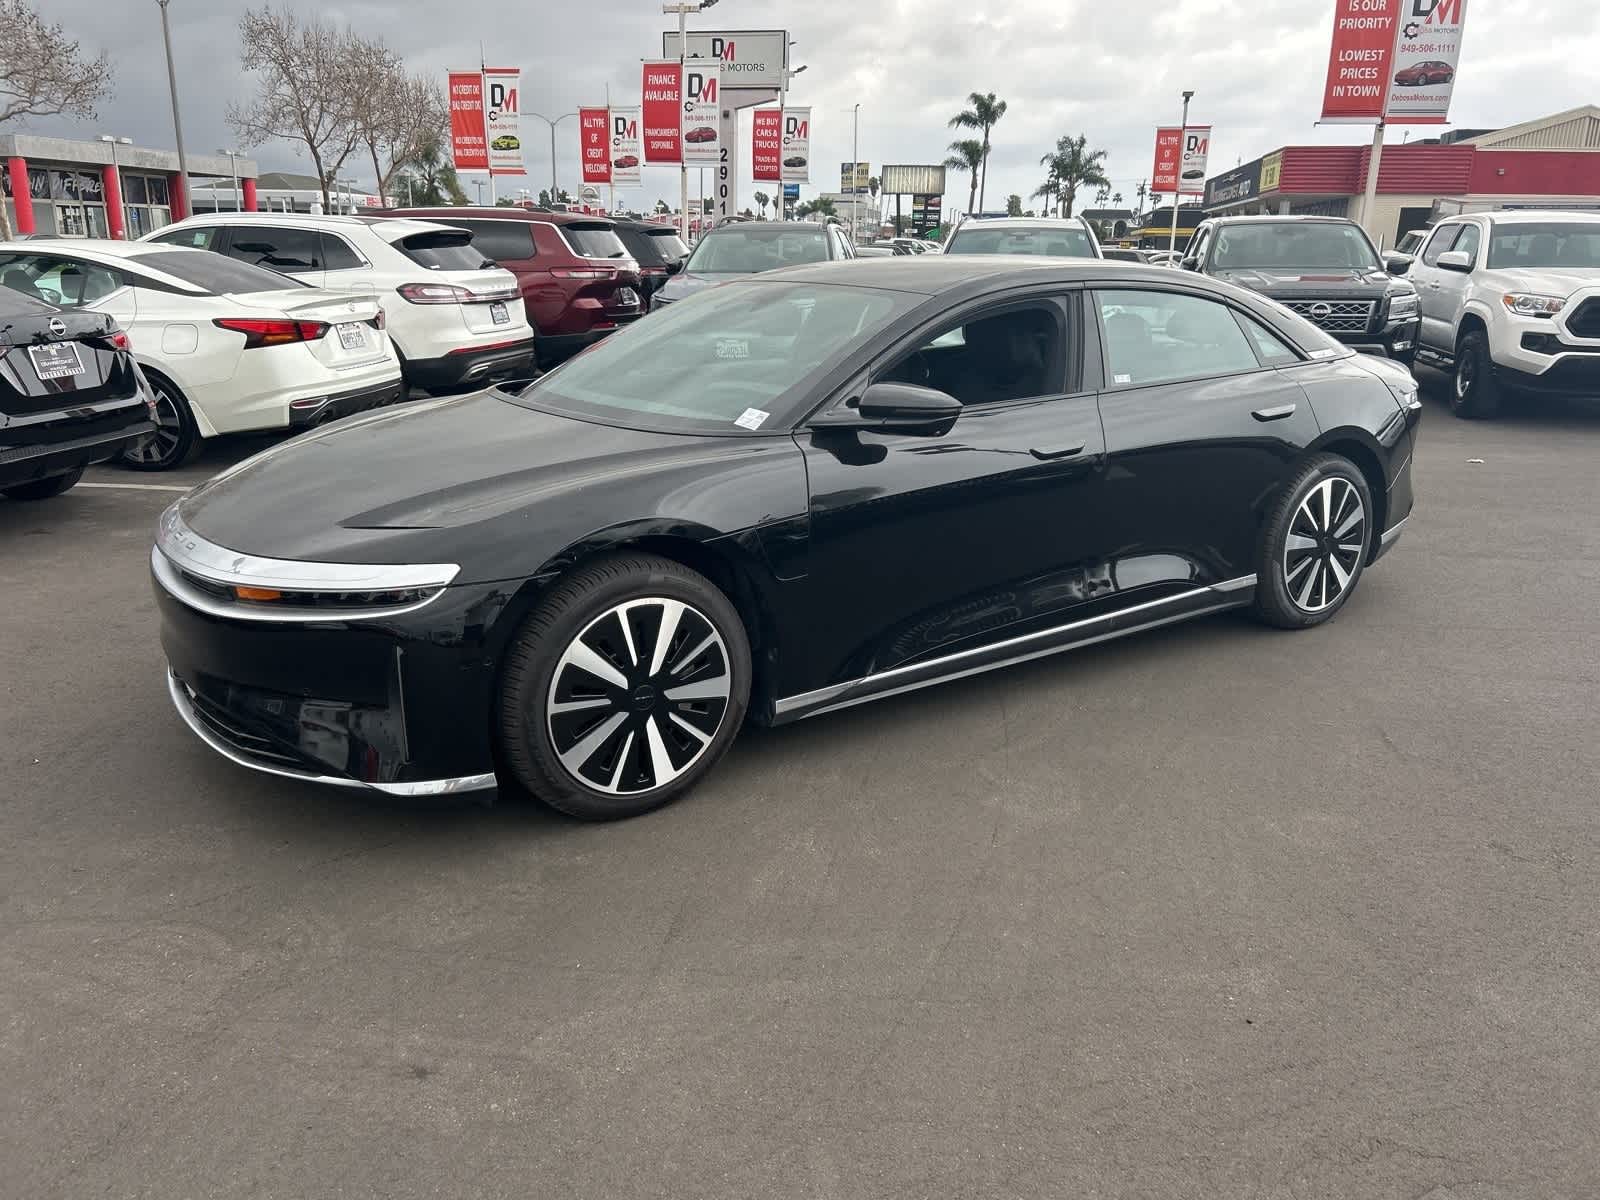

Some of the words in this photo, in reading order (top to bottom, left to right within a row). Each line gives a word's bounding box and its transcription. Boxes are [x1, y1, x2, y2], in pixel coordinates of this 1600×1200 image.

[1349, 0, 1359, 11] IS
[1361, 0, 1386, 11] OUR
[1339, 17, 1392, 30] PRIORITY
[712, 38, 735, 61] DM
[1401, 43, 1456, 53] 949-506-1111
[1339, 49, 1385, 62] LOWEST
[728, 63, 765, 72] MOTORS
[1339, 67, 1378, 80] PRICES
[648, 74, 676, 85] FINANCE
[688, 73, 716, 103] DM
[1332, 86, 1345, 97] IN
[1348, 86, 1381, 97] TOWN
[491, 83, 517, 112] DM
[644, 90, 679, 101] AVAILABLE
[583, 117, 593, 128] ALL
[593, 117, 605, 128] TYPE
[756, 117, 766, 126] WE
[766, 117, 778, 126] BUY
[615, 117, 637, 139] DM
[756, 128, 772, 137] CARS
[772, 129, 778, 137] &
[786, 117, 808, 139] DM
[591, 133, 598, 143] OF
[1159, 136, 1167, 145] ALL
[755, 140, 779, 149] TRUCKS
[1186, 135, 1208, 155] DM
[586, 148, 604, 158] CREDIT
[755, 155, 777, 163] TRADE-IN
[584, 163, 608, 173] WELCOME
[31, 175, 45, 191] IN
[719, 147, 728, 216] 2901
